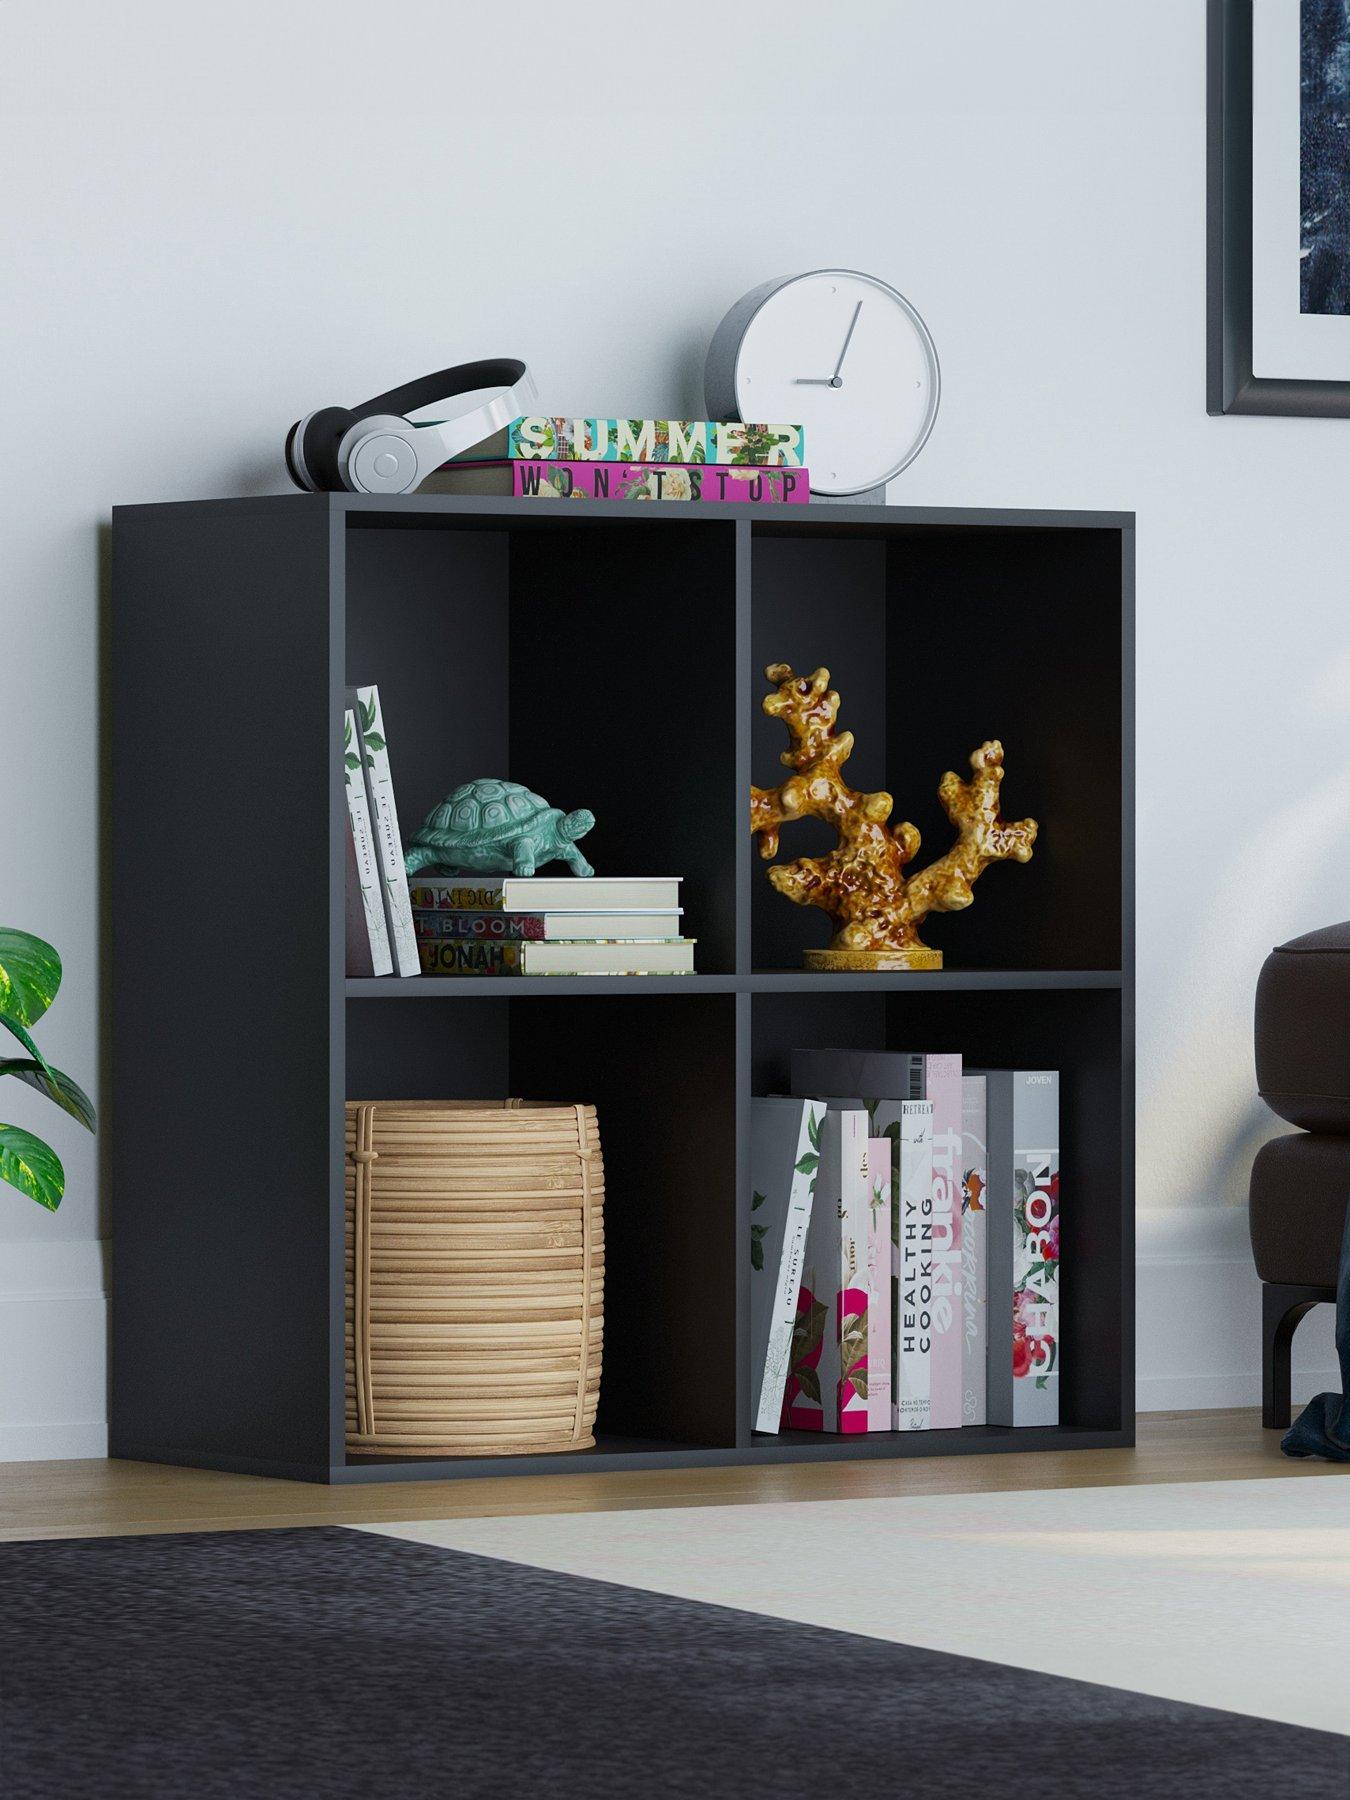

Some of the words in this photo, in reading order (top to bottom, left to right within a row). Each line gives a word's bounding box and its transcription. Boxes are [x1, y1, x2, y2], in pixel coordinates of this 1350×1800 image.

[520, 417, 802, 466] SUMMER
[690, 469, 796, 502] STOP
[442, 919, 525, 934] BLOOM
[429, 943, 505, 969] JONAH
[1025, 1075, 1052, 1085] JOVEN
[903, 1103, 934, 1115] RETREAT
[932, 1127, 963, 1335] frankie
[903, 1200, 917, 1353] HEALTHY
[919, 1198, 933, 1354] COOKING
[1024, 1153, 1053, 1373] CHABON
